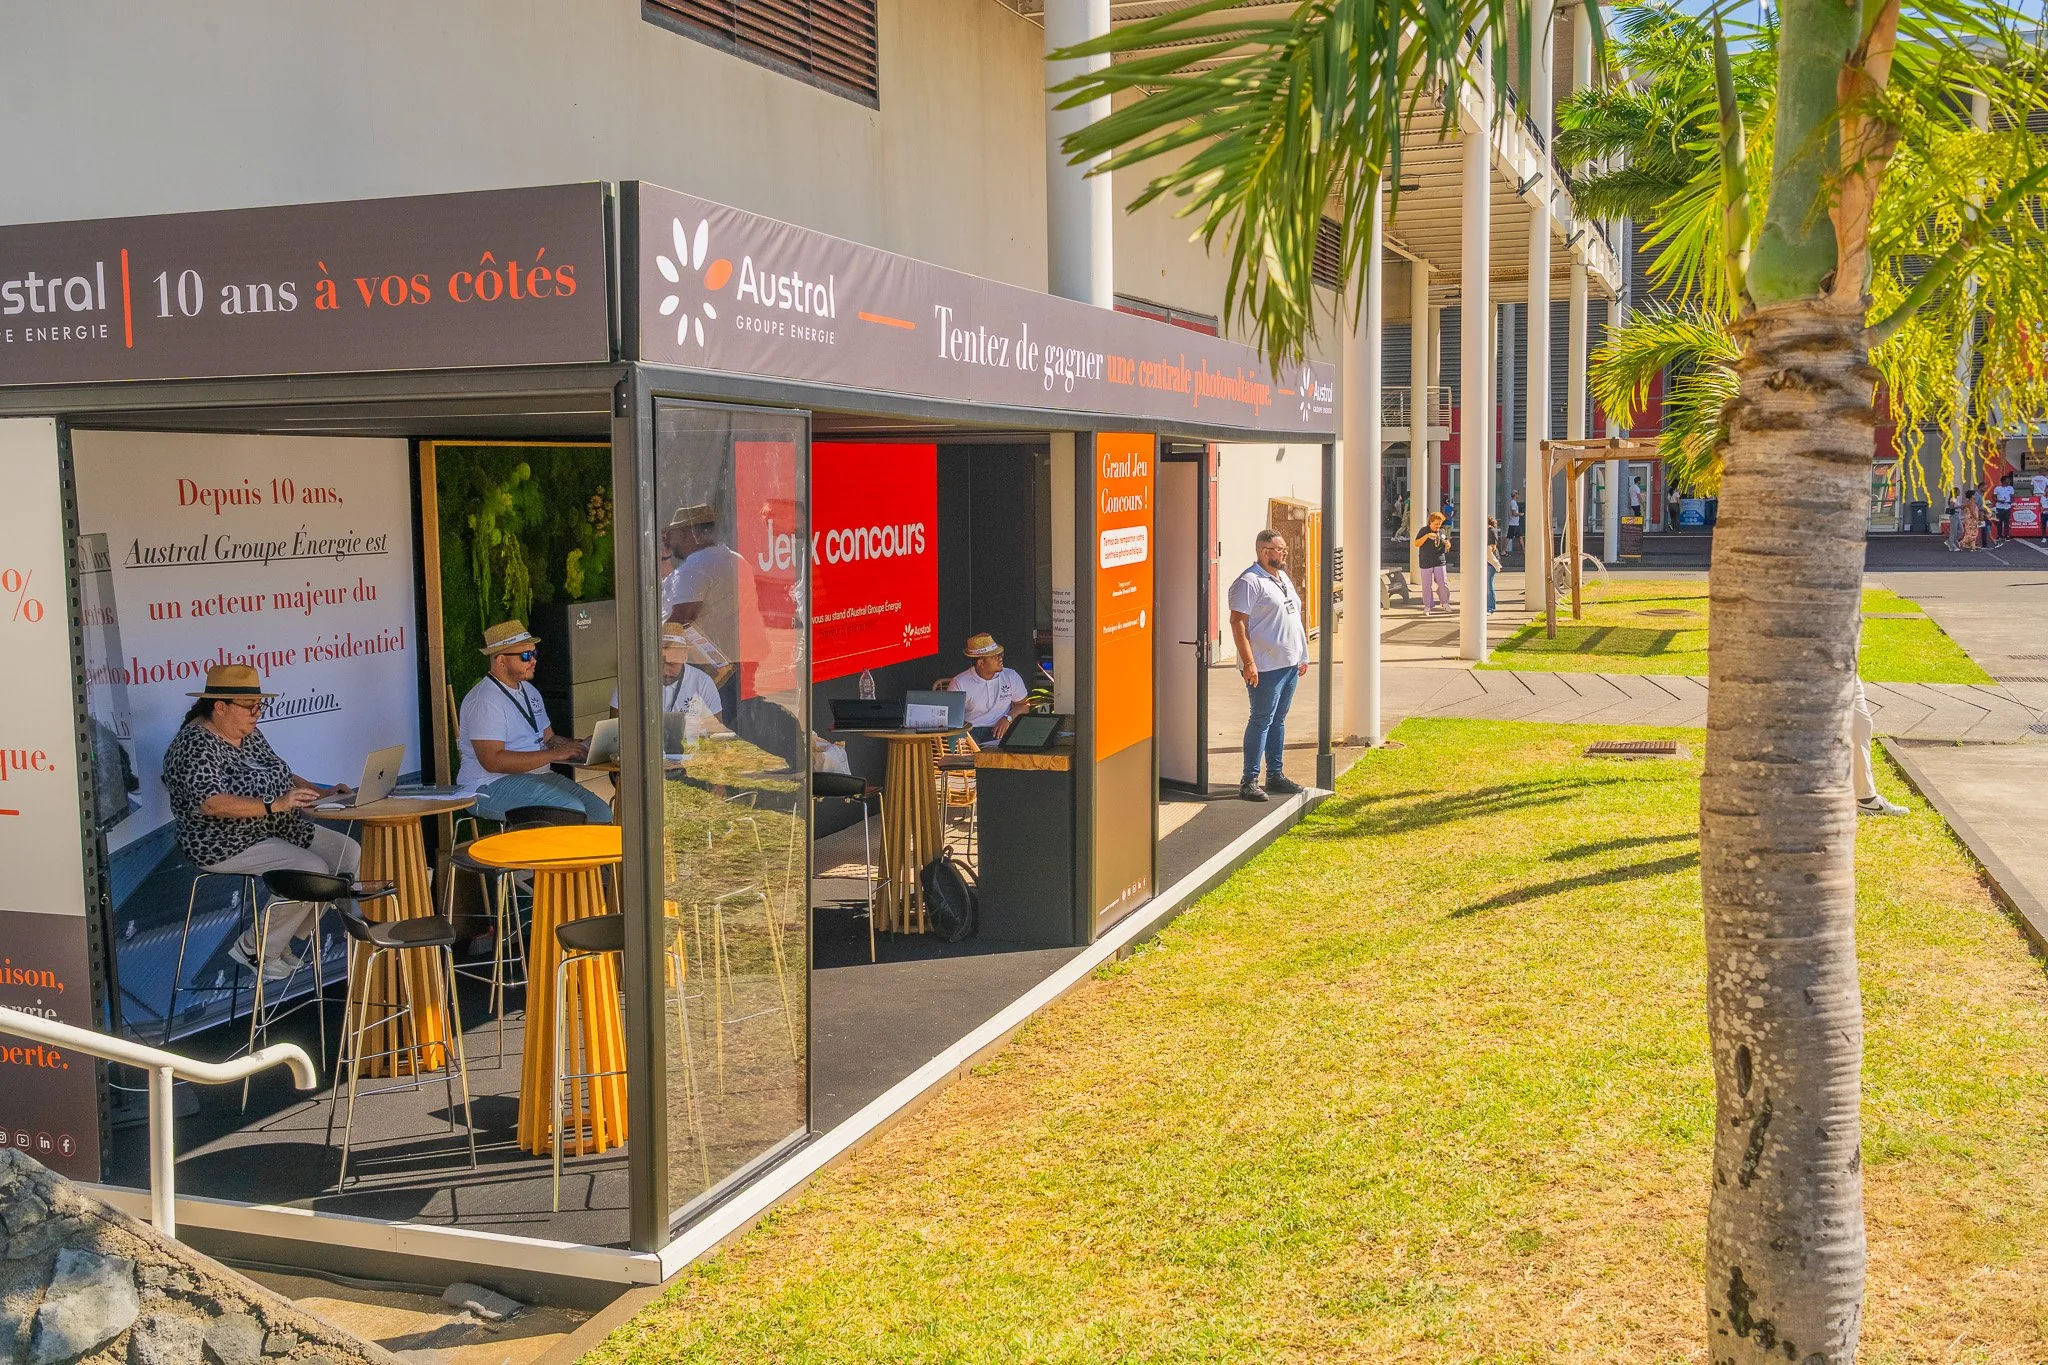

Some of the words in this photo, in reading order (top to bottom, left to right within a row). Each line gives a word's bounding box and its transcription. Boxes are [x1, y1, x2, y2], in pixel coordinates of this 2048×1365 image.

[152, 269, 204, 318] 10
[220, 279, 299, 315] ans
[315, 262, 341, 311] à
[353, 273, 432, 309] vos
[448, 247, 578, 303] côtés
[736, 256, 836, 319] Austral
[25, 324, 108, 342] ENERGIE
[736, 315, 785, 337] GROUPE
[790, 326, 835, 345] ENERGIE
[934, 304, 1010, 368] Tentez
[1015, 322, 1039, 373] de
[1043, 344, 1104, 393] gagner
[1107, 355, 1136, 386] une
[1138, 353, 1192, 394] centrale
[1313, 380, 1333, 403] Austral
[1102, 452, 1131, 479] Grand
[1132, 452, 1148, 478] Jeu
[176, 478, 262, 515] Depuis
[270, 477, 295, 505] 10
[302, 486, 344, 509] ans,
[1101, 487, 1143, 514] Concours
[123, 534, 209, 566] Austral
[214, 534, 287, 567] Groupe
[292, 524, 362, 562] Énergie
[366, 532, 388, 552] est
[758, 518, 821, 572] Jex
[825, 522, 925, 564] concours
[1, 568, 44, 623] %
[148, 599, 183, 621] un
[191, 592, 266, 618] acteur
[272, 581, 348, 616] majeur
[353, 577, 378, 602] du
[832, 610, 847, 621] stand
[868, 604, 885, 616] Groupe
[304, 626, 406, 663] résidentiel
[913, 623, 932, 636] Austral
